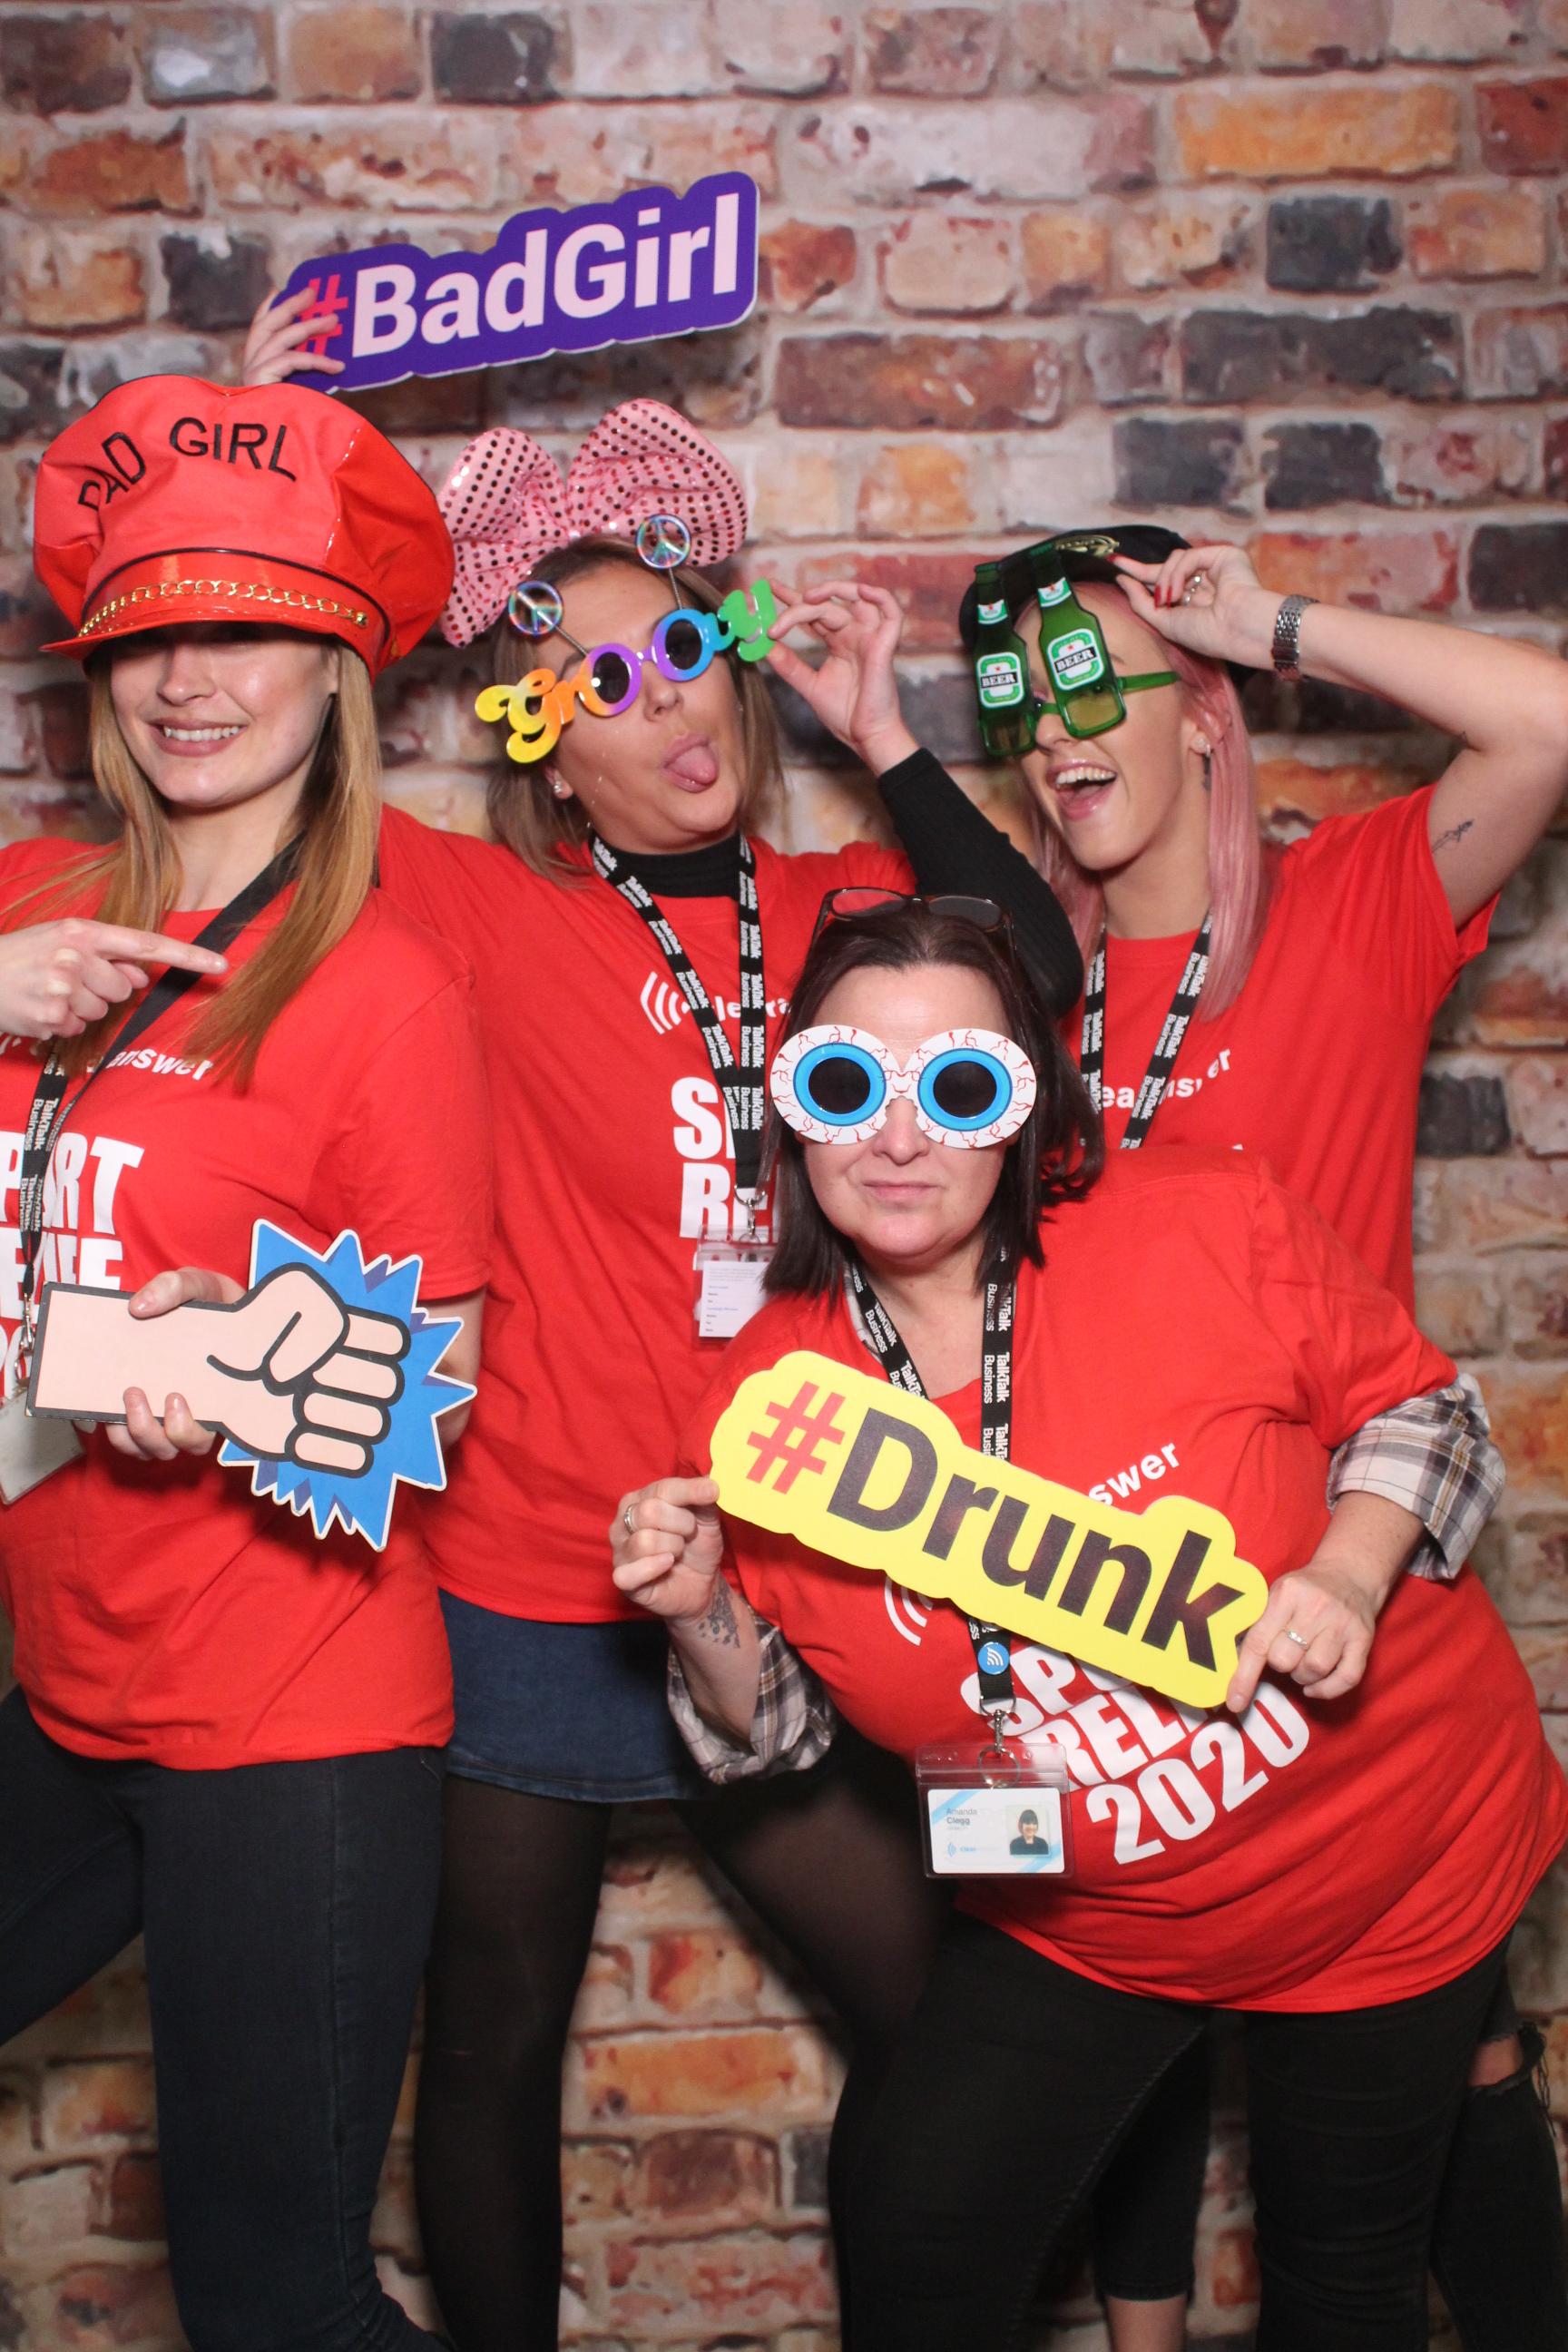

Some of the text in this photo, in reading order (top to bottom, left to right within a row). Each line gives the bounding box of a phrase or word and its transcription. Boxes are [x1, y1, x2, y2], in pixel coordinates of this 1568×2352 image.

[296, 192, 740, 359] #BadGirl
[169, 416, 297, 483] GIRL
[981, 672, 1016, 688] BEER
[1056, 648, 1095, 671] BEER
[701, 1026, 721, 1070] Business
[711, 1023, 734, 1067] TalkTalk
[740, 1025, 750, 1067] Business
[752, 1024, 764, 1068] TalkTalk
[34, 1098, 59, 1151] TalkTalk
[740, 1087, 750, 1131] Business
[751, 1086, 764, 1132] TalkTalk
[865, 1308, 888, 1354] Business
[984, 1355, 995, 1404] Business
[996, 1352, 1010, 1403] TalkTalk
[746, 1380, 1245, 1671] #Drunk
[1085, 1681, 1309, 1866] 2020
